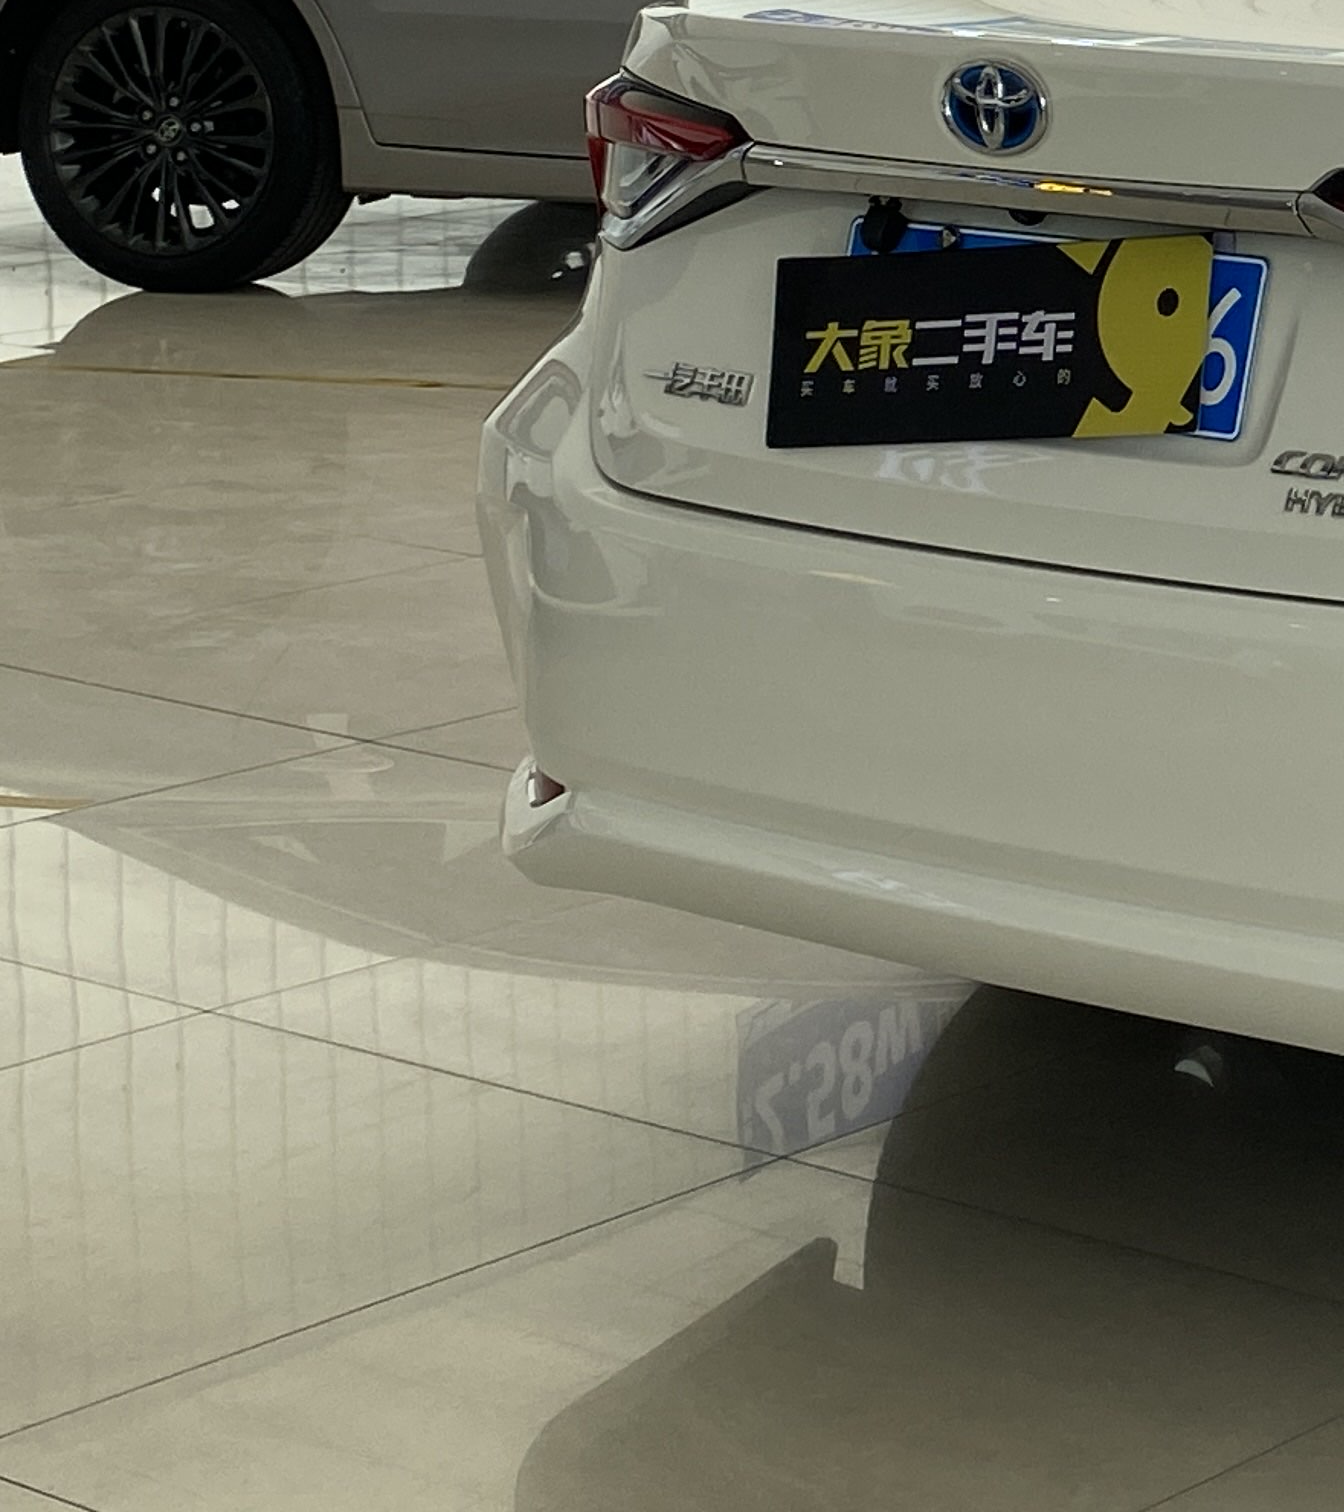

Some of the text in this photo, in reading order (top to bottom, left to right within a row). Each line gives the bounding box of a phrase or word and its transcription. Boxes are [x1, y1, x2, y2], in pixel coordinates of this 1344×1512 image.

[804, 310, 1076, 374] 大象二手车
